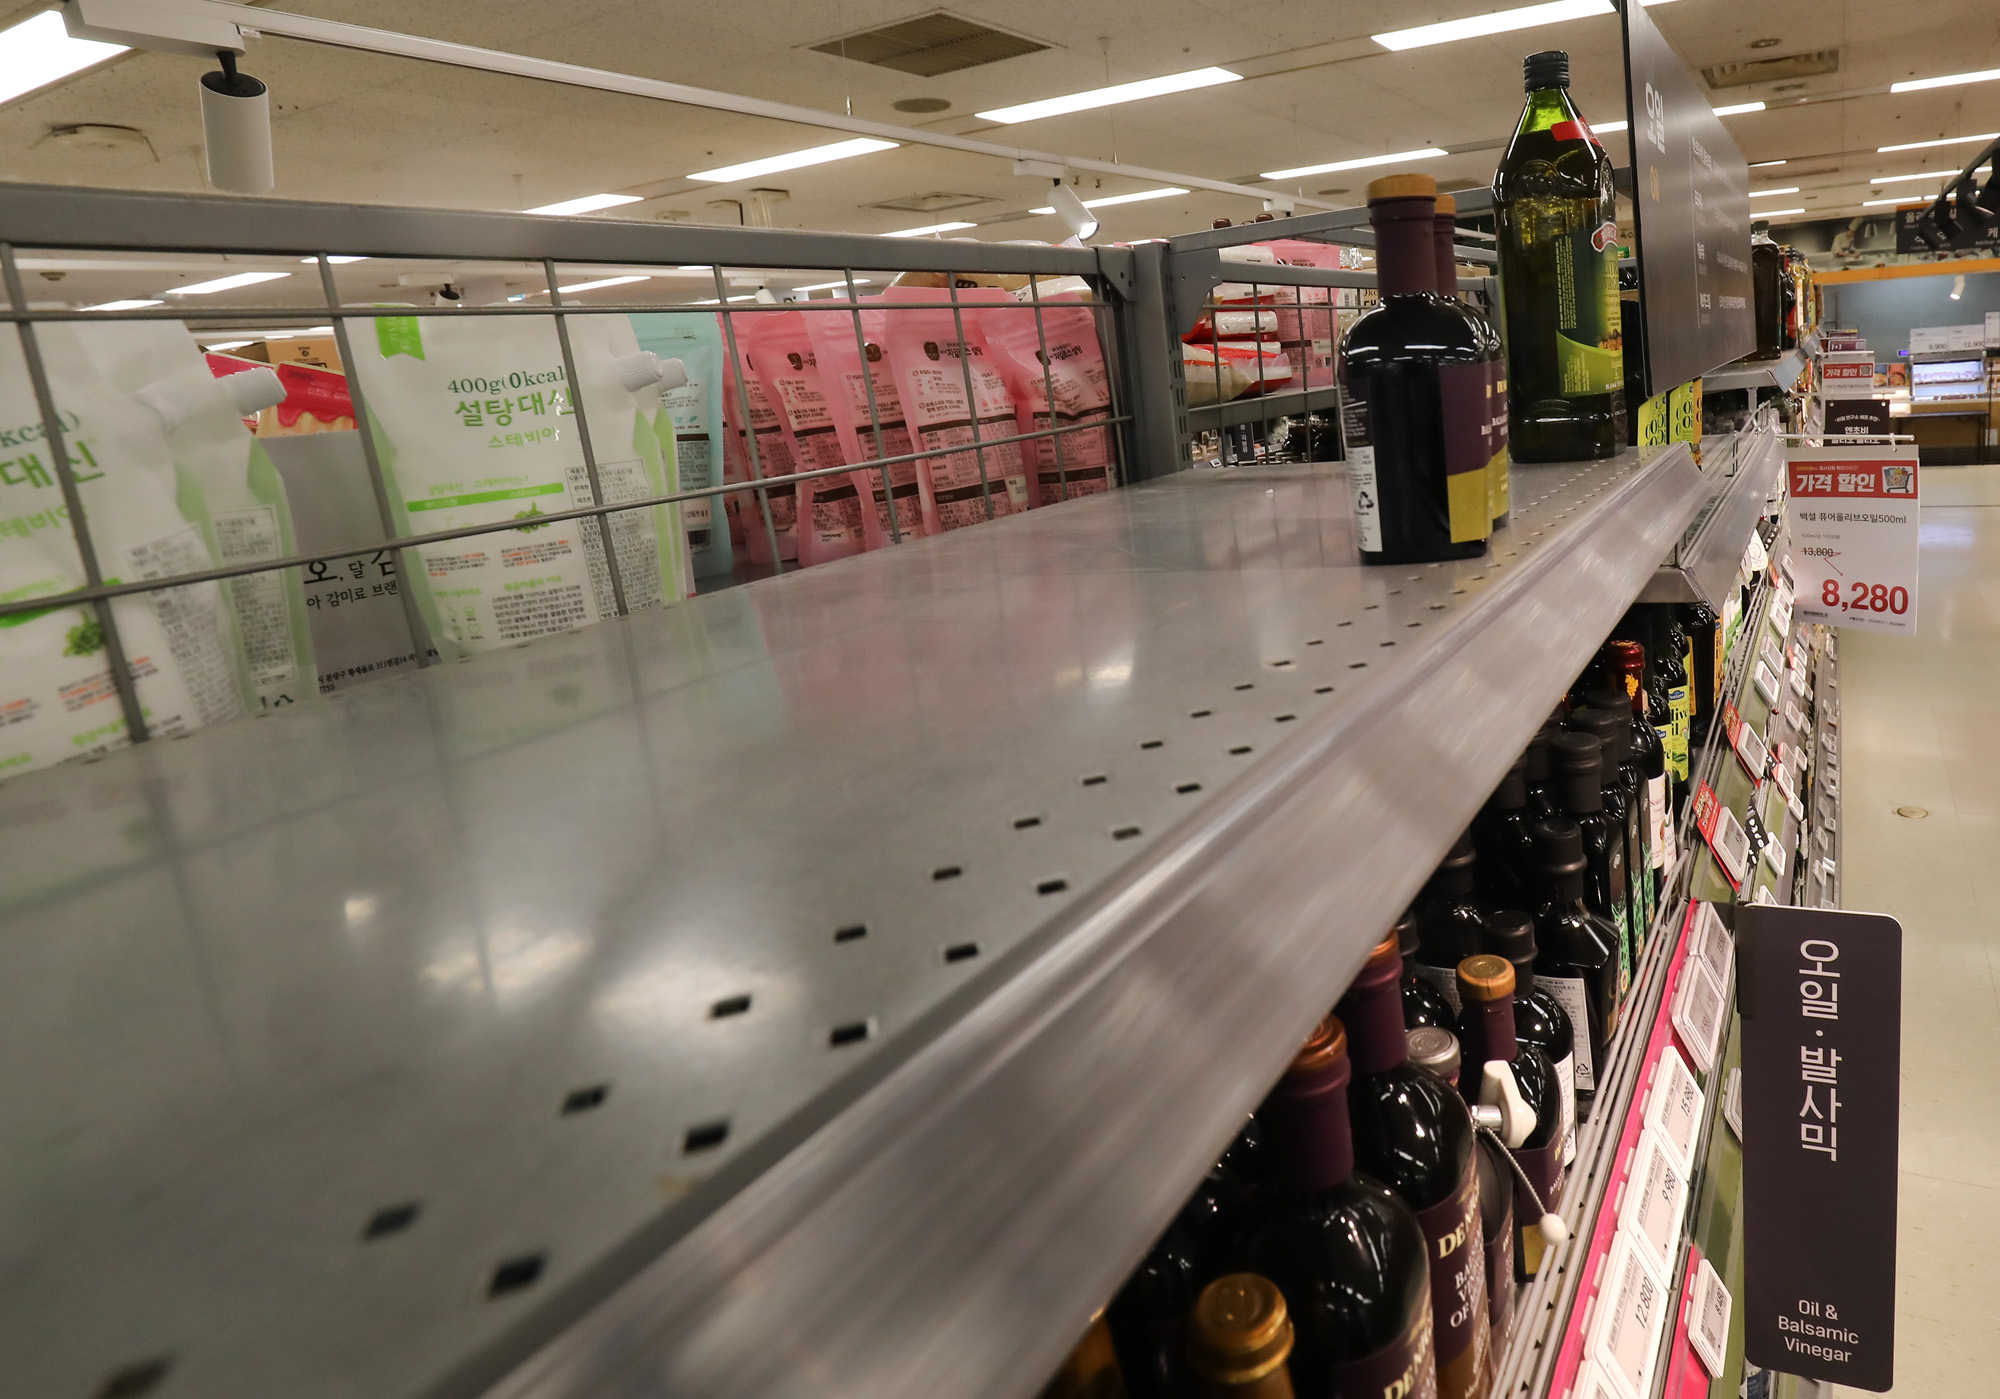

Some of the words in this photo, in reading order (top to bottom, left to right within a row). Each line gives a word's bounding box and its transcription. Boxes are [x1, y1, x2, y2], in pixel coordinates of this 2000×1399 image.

[488, 425, 560, 449] 스테비아
[1796, 473, 1833, 493] 가격
[1838, 473, 1876, 493] 할인
[1800, 512, 1817, 522] 백설
[1802, 547, 1834, 558] 13,800
[348, 561, 365, 579] 달
[327, 587, 368, 608] 감미료
[1821, 579, 1909, 615] 8,280
[1798, 1299, 1820, 1317] Oil
[1825, 1304, 1839, 1321] &
[1778, 1315, 1859, 1345] Balsamic
[1784, 1336, 1853, 1363] Vinegar
